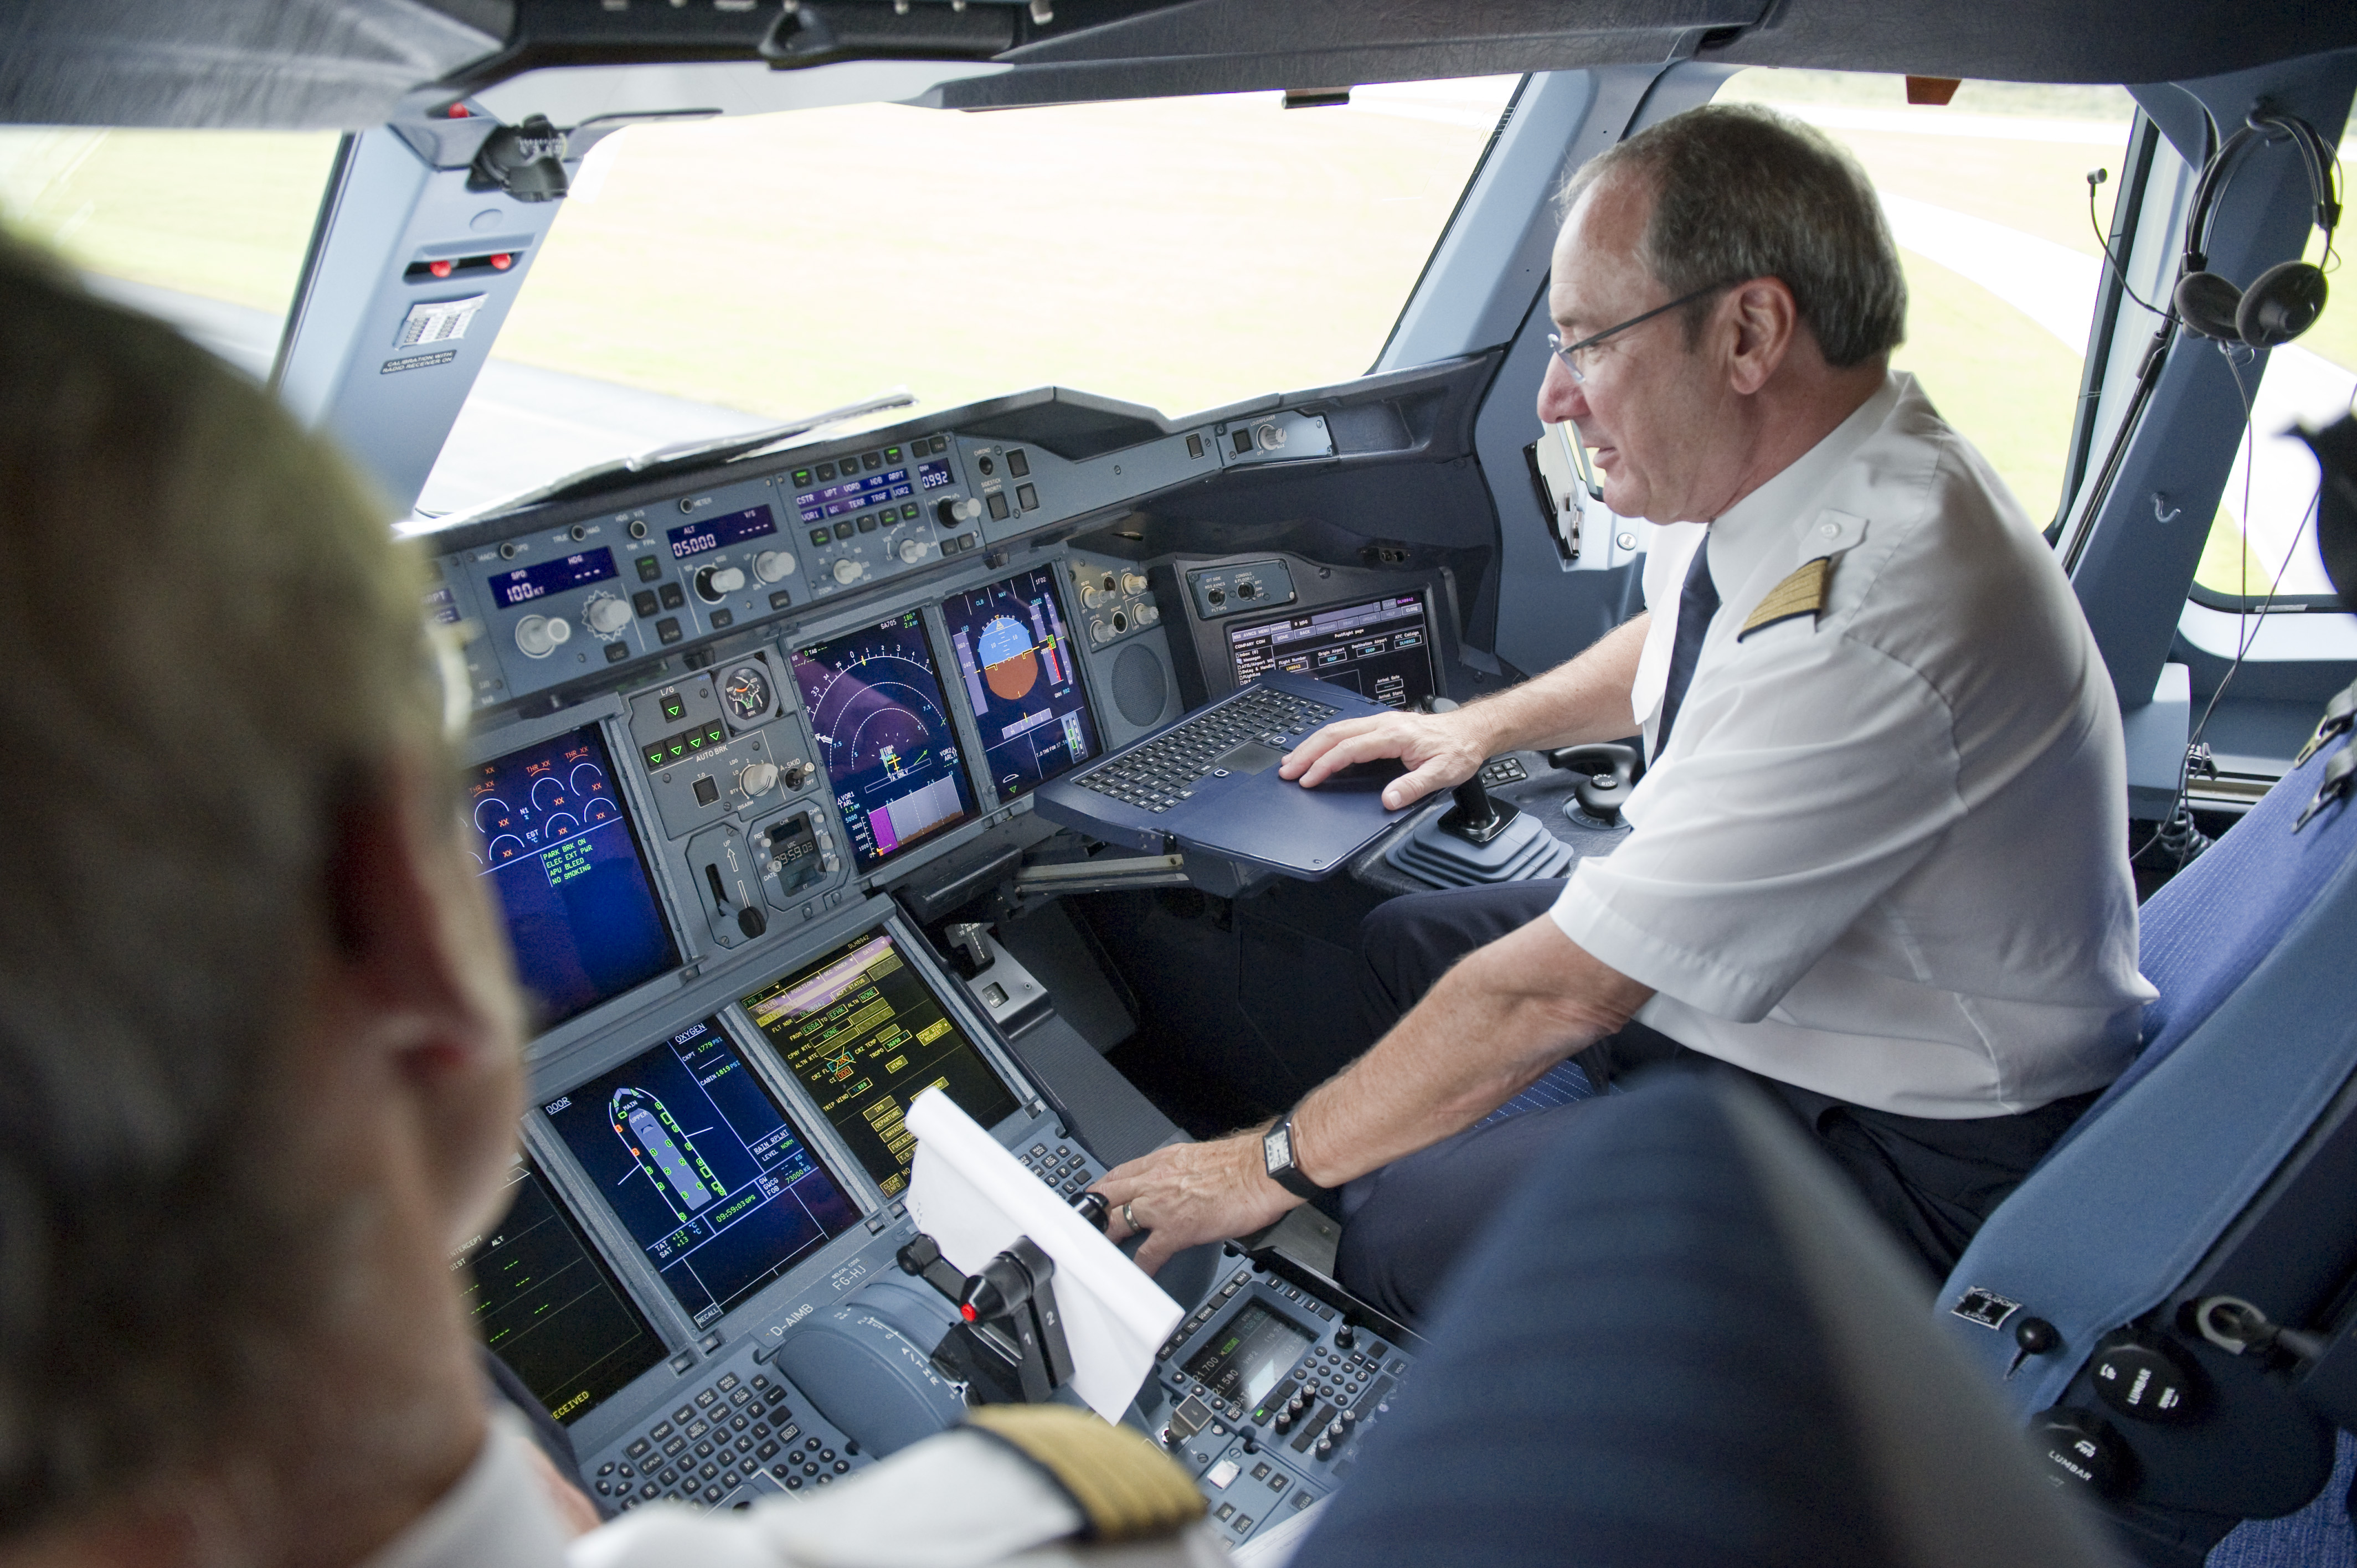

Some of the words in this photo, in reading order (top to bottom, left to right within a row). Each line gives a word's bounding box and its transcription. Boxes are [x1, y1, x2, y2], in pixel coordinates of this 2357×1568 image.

[382, 365, 405, 373] RADIO
[405, 358, 440, 369] RECEIVER
[387, 355, 433, 367] CALIBRATION
[1250, 415, 1277, 427] LOUDSPEAKER
[922, 471, 949, 488] 0992
[980, 477, 1002, 487] SIDESTICK
[796, 493, 815, 504] CSTR
[824, 488, 837, 497] WPT
[869, 476, 883, 486] NDB
[888, 471, 904, 481] ARPT
[801, 510, 819, 521] VOR1
[848, 498, 866, 509] TERR
[871, 492, 887, 502] TRAF
[893, 487, 909, 497] VOR2
[683, 526, 695, 534] ALT
[672, 533, 717, 557] 05000
[568, 555, 583, 565] HDG
[511, 570, 527, 580] SPD
[881, 619, 897, 630] SA705
[1235, 641, 1254, 649] COMPANY
[811, 686, 820, 697] 33
[565, 750, 577, 759] THR
[696, 750, 713, 762] AUTO
[714, 745, 728, 756] BRK
[940, 747, 952, 757] VOR2
[526, 764, 539, 773] THR
[780, 758, 801, 771] A-SKID
[841, 791, 855, 801] VOR1
[737, 800, 754, 810] DISARM
[845, 814, 858, 823] 5000
[852, 822, 862, 831] 3000
[526, 829, 539, 840] EGT
[753, 831, 765, 840] RST
[855, 833, 866, 841] 2000
[543, 848, 560, 860] PARK
[562, 842, 575, 853] BRK
[577, 838, 586, 847] ON
[802, 842, 814, 853] 03
[546, 857, 563, 869] ELEC
[565, 852, 578, 861] EXT
[580, 844, 593, 855] PWR
[549, 867, 562, 876] APU
[564, 858, 585, 870] BLEED
[552, 876, 562, 885] NO
[564, 864, 591, 879] SMOKING
[763, 872, 778, 881] DATE
[863, 947, 874, 956] DATA
[790, 980, 814, 995] POSITION
[771, 1024, 782, 1033] FLT
[799, 1000, 826, 1018] DLH8942
[789, 1031, 802, 1041] FROM
[802, 1022, 820, 1033] ESSA
[829, 1007, 845, 1019] EFHK
[860, 989, 876, 1001] NONE
[675, 1023, 706, 1043] OXYGEN
[930, 1023, 942, 1033] WIND
[924, 1029, 943, 1042] REQUEST
[788, 1050, 800, 1060] CPNY
[801, 1043, 812, 1051] RTE
[822, 1027, 839, 1039] NONE
[795, 1060, 808, 1069] ALTN
[809, 1053, 819, 1061] RTE
[891, 1060, 903, 1069] WIND
[545, 1097, 571, 1114] DOOR
[622, 1100, 638, 1111] MAIN
[875, 1104, 884, 1112] IRS
[630, 1111, 649, 1123] UPPER
[874, 1110, 900, 1128] DEPARTURE
[753, 1142, 769, 1154] RAIN
[770, 1129, 789, 1143] RPLNT
[762, 1150, 779, 1162] LEVEL
[780, 1138, 794, 1149] NORM
[763, 1178, 779, 1190] GWCG
[883, 1178, 899, 1190] CLEAR
[888, 1183, 900, 1193] INFO
[716, 1200, 747, 1223] 09:59:03
[745, 1194, 756, 1204] GPS
[491, 1235, 505, 1247] ALT
[655, 1240, 668, 1252] TAT
[672, 1230, 685, 1241] +13
[659, 1247, 673, 1258] SAT
[677, 1236, 689, 1247] +13
[831, 1267, 848, 1280] SELCAL
[848, 1257, 861, 1268] CODE
[832, 1265, 867, 1291] FG-HJ
[1238, 1272, 1247, 1282] NAV
[1223, 1283, 1236, 1295] MENU
[1046, 1311, 1055, 1326] 2
[1198, 1307, 1212, 1320] SQWK
[770, 1303, 814, 1337] D-AIMB
[721, 1376, 733, 1385] MAIL
[724, 1380, 735, 1390] BOX
[699, 1391, 711, 1401] NAV
[679, 1410, 690, 1420] INIT
[712, 1407, 726, 1419] SURV
[654, 1425, 668, 1437] PERF
[783, 1427, 795, 1438] ENT
[634, 1444, 644, 1453] DIR
[667, 1440, 682, 1453] DEST
[2049, 1450, 2093, 1481] LUMBAR
